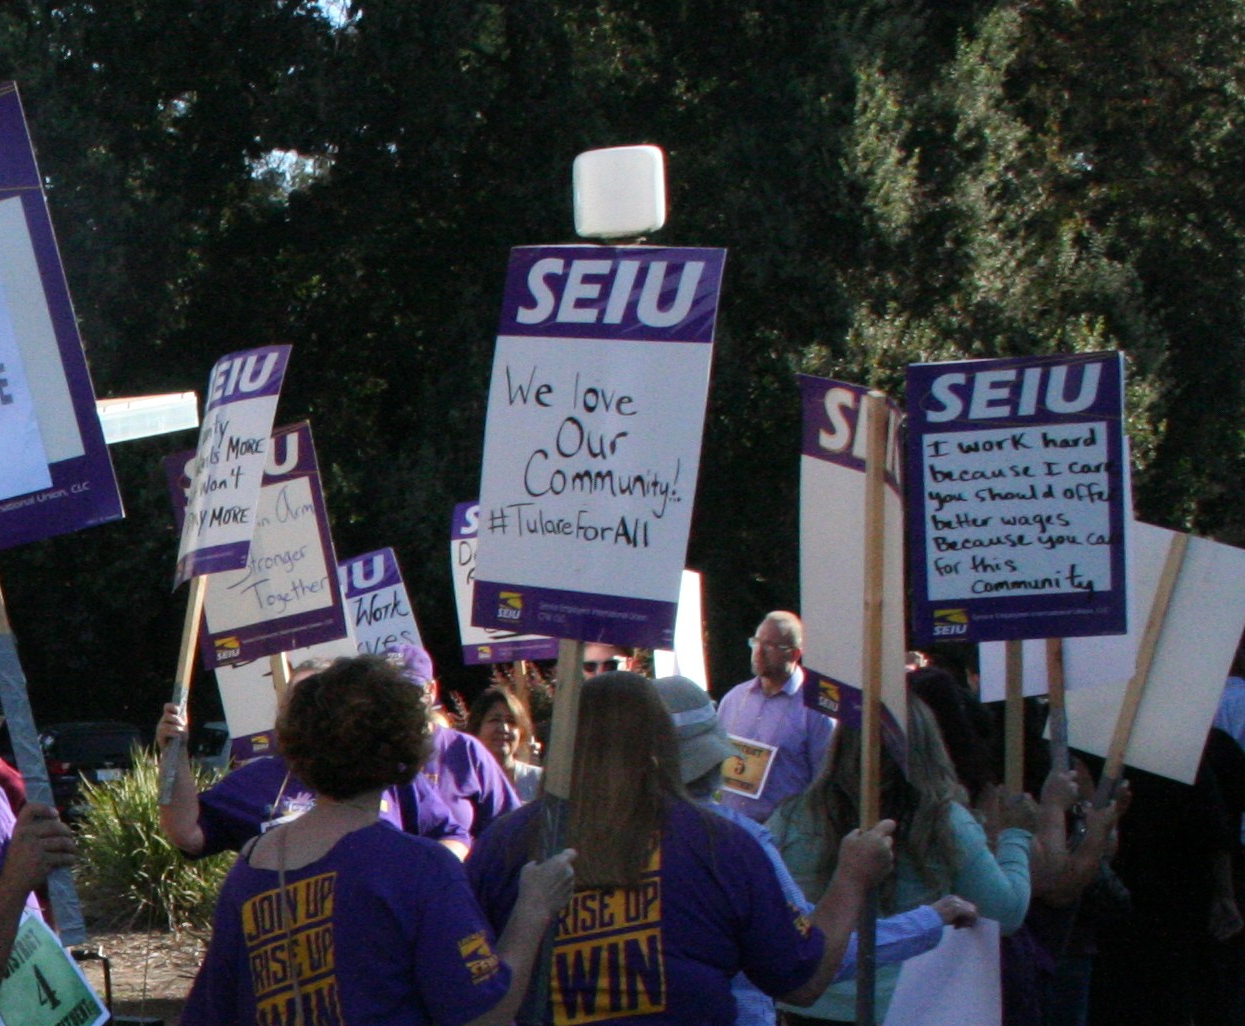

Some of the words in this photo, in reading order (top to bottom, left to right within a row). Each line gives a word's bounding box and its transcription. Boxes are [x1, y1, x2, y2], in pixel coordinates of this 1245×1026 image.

[515, 257, 705, 328] SEIU
[209, 352, 280, 401] EIU
[505, 364, 553, 407] We
[574, 371, 637, 417] love
[926, 362, 1103, 423] SEIU
[226, 436, 267, 462] MORE
[556, 416, 630, 460] Our
[926, 440, 949, 458] I
[1041, 427, 1097, 448] hard
[524, 448, 683, 518] Community!
[928, 463, 1036, 483] because
[1043, 461, 1063, 477] I
[208, 506, 251, 528] MORE
[928, 489, 968, 512] you
[975, 483, 1056, 503] should
[1063, 481, 1113, 504] offe
[488, 502, 650, 548] #TulareForAll
[931, 513, 992, 531] better
[1001, 512, 1070, 534] wages
[932, 534, 1032, 552] Because
[1037, 534, 1082, 550] you
[227, 544, 308, 591] Stronger
[338, 553, 385, 594] IU
[970, 554, 1018, 574] this
[240, 576, 329, 614] Together
[354, 590, 411, 627] Work
[932, 623, 968, 636] SEIU
[216, 648, 241, 661] SEIU
[248, 887, 299, 944] JOIN
[306, 876, 334, 919] UP
[556, 892, 616, 938] RISE
[624, 881, 658, 924] UP
[251, 938, 303, 991] RISE
[306, 925, 334, 972] UP
[557, 934, 664, 1020] WIN
[32, 963, 62, 1011] 4
